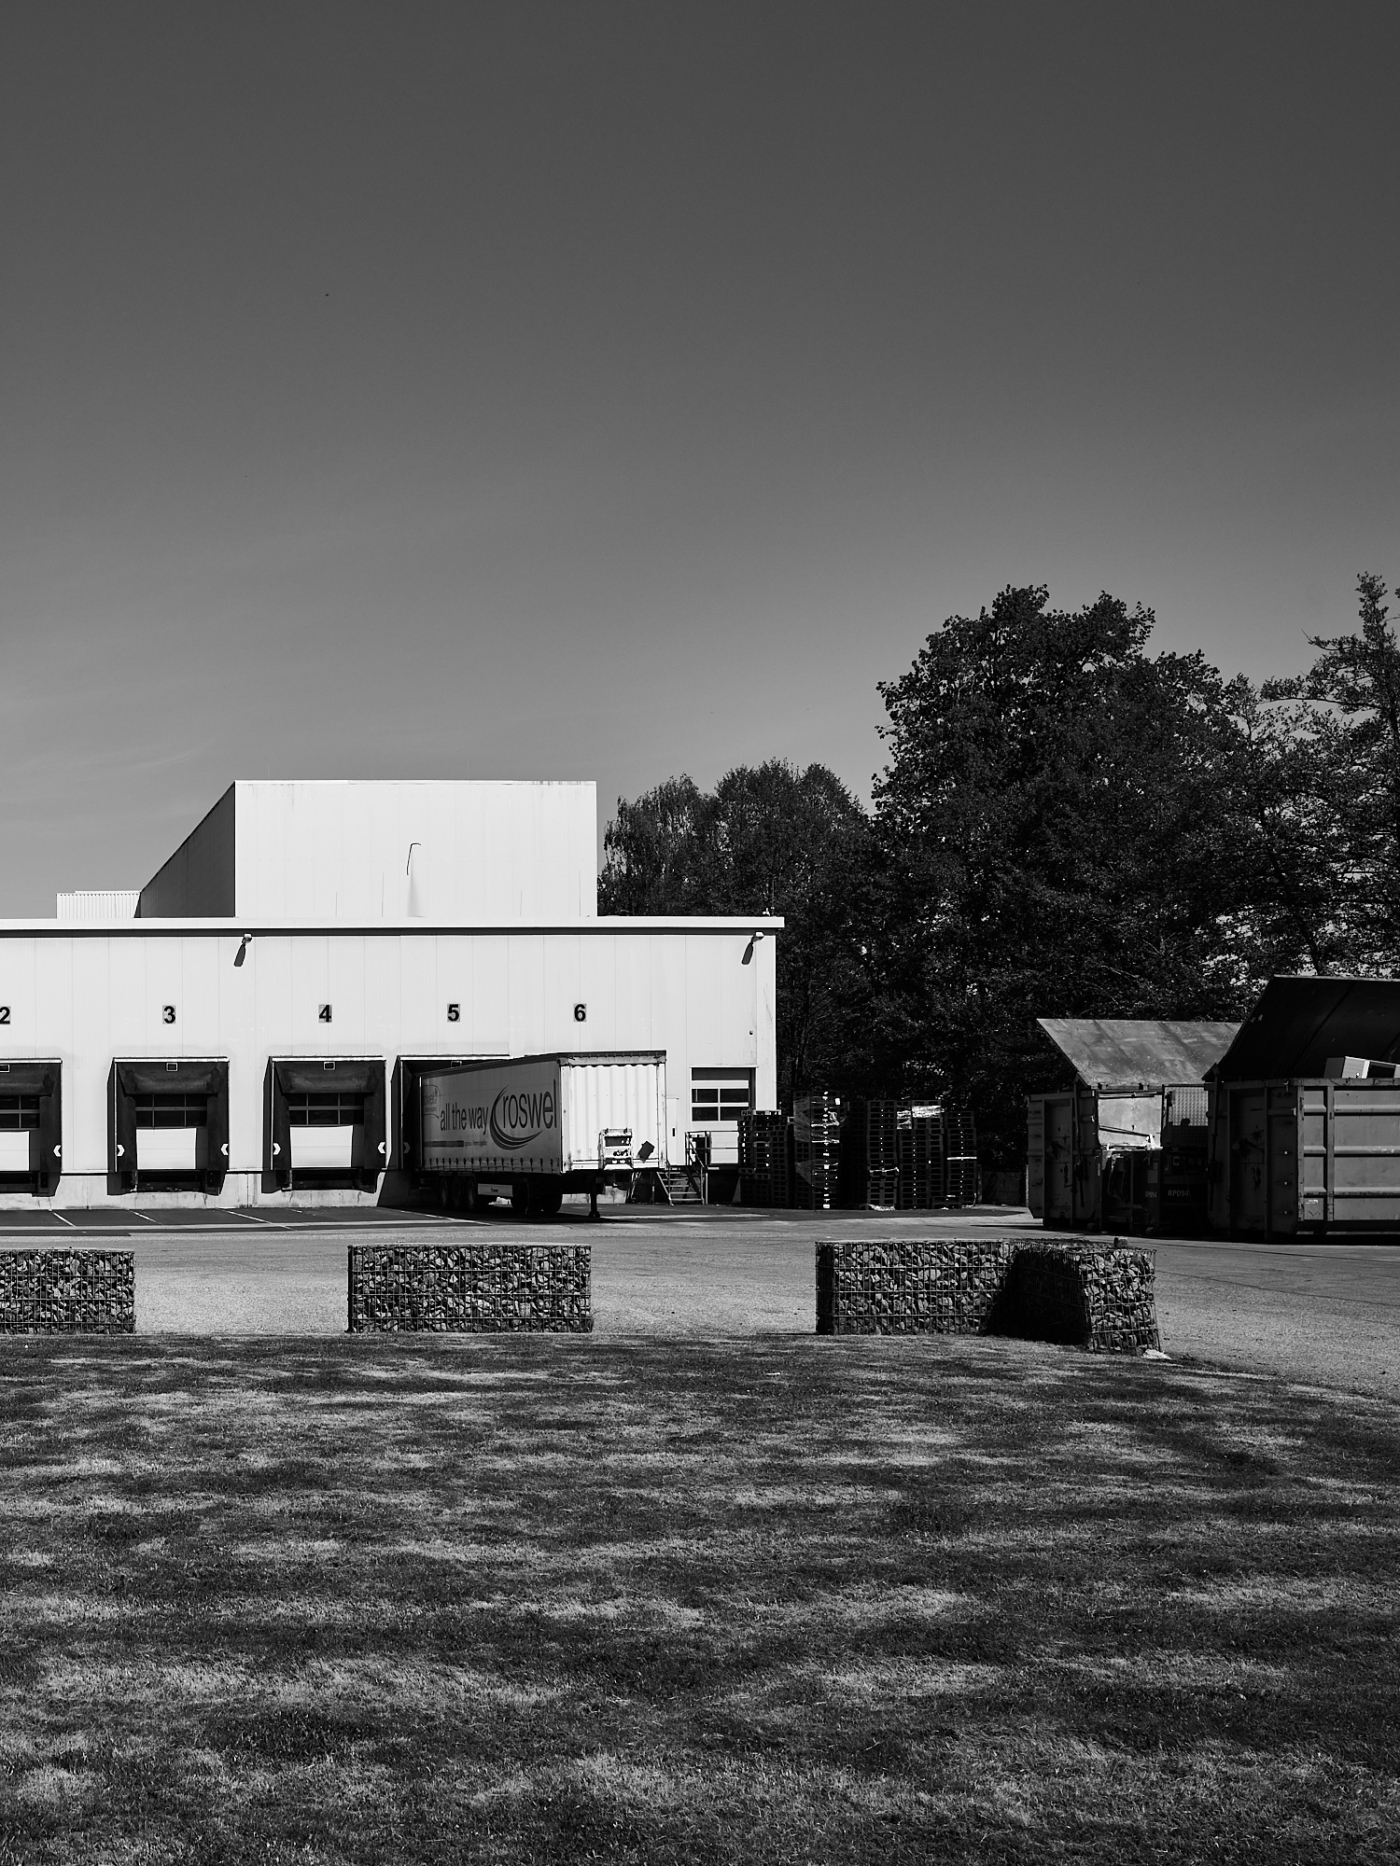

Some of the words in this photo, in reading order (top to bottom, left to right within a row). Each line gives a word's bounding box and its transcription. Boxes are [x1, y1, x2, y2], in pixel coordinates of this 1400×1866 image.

[163, 1005, 176, 1023] 3
[318, 1004, 332, 1022] 4
[447, 1003, 460, 1021] 5
[574, 1003, 586, 1021] 6
[439, 1102, 451, 1131] all
[451, 1102, 467, 1131] the
[467, 1105, 489, 1135] way
